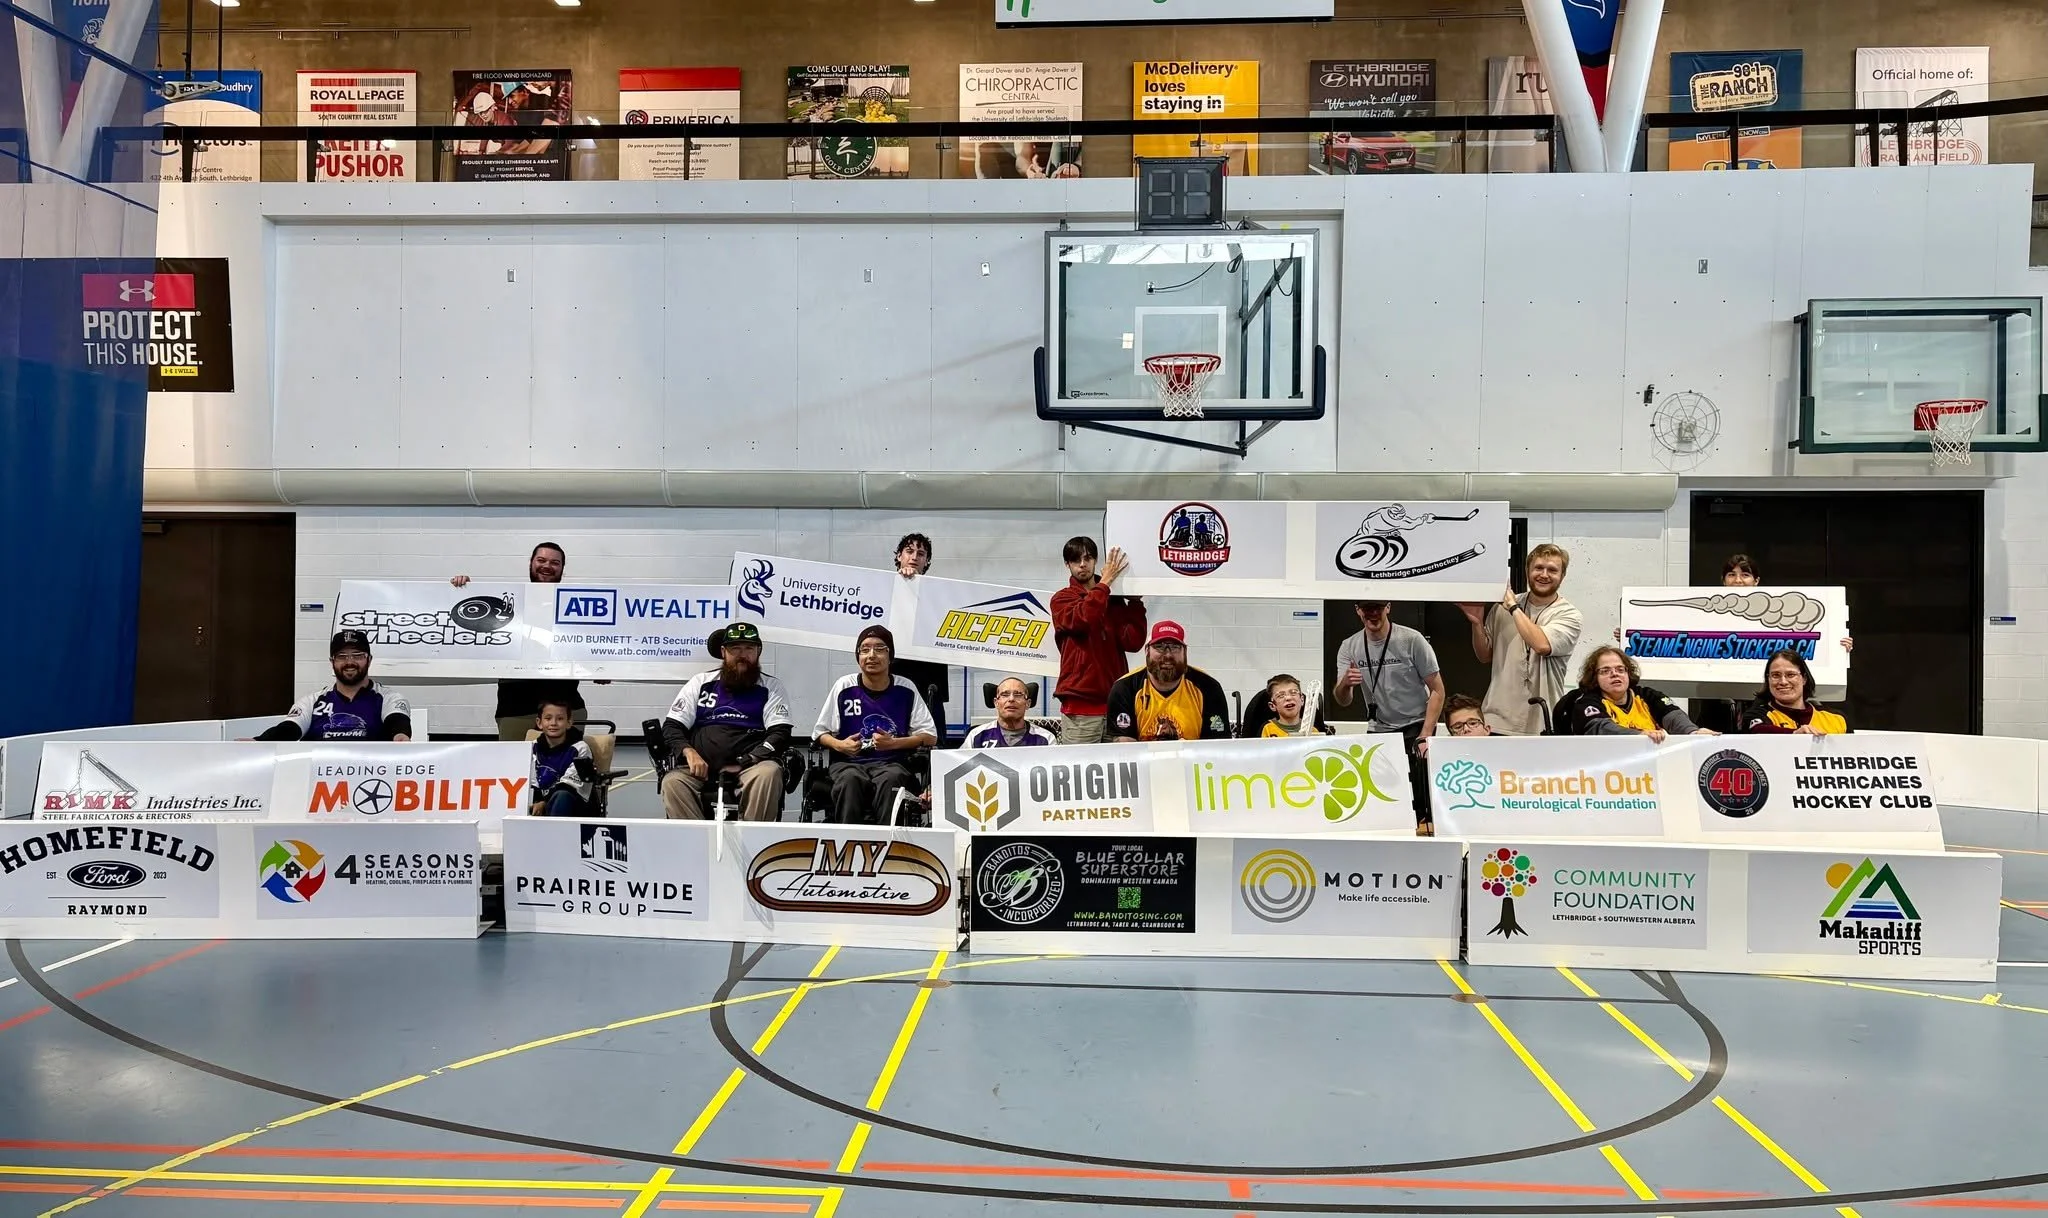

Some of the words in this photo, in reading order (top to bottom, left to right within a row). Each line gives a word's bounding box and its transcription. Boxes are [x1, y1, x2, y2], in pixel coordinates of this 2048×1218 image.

[806, 65, 830, 73] COME
[1321, 63, 1430, 72] LETHBRIDGE
[1872, 68, 1916, 80] Official
[1919, 69, 1954, 79] home
[1957, 68, 1973, 79] of:
[965, 76, 1078, 92] CHIROPRACTIC
[1144, 79, 1186, 93] loves
[1349, 74, 1430, 87] HYUNDAI
[1709, 76, 1769, 99] RANCH
[310, 90, 356, 101] ROYAL
[1001, 92, 1041, 101] CENTRAL
[1380, 91, 1398, 104] sell
[1399, 93, 1417, 107] you
[1700, 83, 1710, 100] THE
[1143, 96, 1203, 112] staying
[1206, 96, 1222, 109] in
[824, 154, 843, 172] GOLF
[843, 154, 872, 174] CENTRE
[1939, 153, 1970, 162] FIELD
[83, 310, 196, 340] PROTECT
[83, 342, 127, 365] THIS
[132, 343, 203, 366] HOUSE.
[1162, 550, 1226, 561] LETHBRIDGE
[1370, 569, 1411, 578] Lethbridge
[1411, 556, 1460, 575] Powerhockey
[782, 576, 845, 597] University
[847, 585, 861, 597] of
[563, 597, 608, 617] ATB
[625, 598, 729, 619] WEALTH
[779, 591, 884, 620] Lethbridge
[339, 609, 452, 627] street
[936, 609, 1051, 650] ACPSA
[553, 634, 583, 644] DAVID
[585, 635, 632, 645] BURNETT
[641, 636, 661, 645] ATB
[662, 636, 709, 646] Securities
[590, 646, 692, 657] www.atb.com/wealth
[934, 641, 956, 649] Alberta
[956, 643, 980, 652] Cerebral
[981, 646, 996, 654] Palsy
[996, 648, 1015, 656] Sports
[1015, 650, 1047, 659] Association
[697, 690, 719, 708] 25
[312, 700, 334, 716] 24
[844, 699, 862, 716] 26
[317, 765, 387, 776] LEADING
[395, 764, 436, 775] EDGE
[1793, 756, 1918, 770] LETHBRIDGE
[1029, 762, 1140, 803] ORIGIN
[1499, 769, 1596, 796] Branch
[1604, 770, 1656, 796] Out
[1709, 767, 1754, 796] 40
[1795, 775, 1923, 790] HURRICANES
[146, 796, 229, 810] Industries
[232, 795, 262, 809] Inc.
[1501, 797, 1582, 813] Neurological
[1585, 797, 1657, 810] Foundation
[1792, 795, 1873, 809] HOCKEY
[1879, 795, 1933, 809] CLUB
[42, 812, 69, 821] STEEL
[71, 812, 135, 821] FABRICATORS
[136, 812, 144, 820] &
[145, 812, 192, 820] ERECTORS
[1042, 806, 1133, 822] PARTNERS
[0, 825, 215, 875] HOMEFIELD
[814, 838, 888, 877] MY
[985, 845, 1031, 871] BANDITOS
[1075, 851, 1116, 864] BLUE
[1122, 852, 1185, 866] COLLAR
[46, 871, 57, 880] EST
[83, 865, 131, 885] Ford
[153, 871, 167, 880] 2023
[334, 854, 361, 885] 4
[364, 853, 474, 869] SEASONS
[365, 869, 404, 879] HOME
[409, 869, 474, 879] COMFORT
[1080, 863, 1179, 877] SUPERSTORE
[776, 872, 912, 901] Automotive
[1323, 871, 1444, 891] MOTION
[1554, 868, 1697, 889] COMMUNITY
[516, 875, 616, 897] PRAIRIE
[627, 880, 693, 901] WIDE
[1003, 880, 1061, 921] INCORPORATED
[1338, 893, 1363, 902] Make
[1365, 893, 1380, 903] life
[1381, 894, 1430, 904] accessible.
[1553, 891, 1695, 912] FOUNDATION
[67, 905, 148, 915] RAYMOND
[562, 900, 647, 917] GROUP
[1073, 911, 1183, 921] WWW.BANDITOSINC.COM
[1552, 914, 1597, 922] LETHBRIDGE
[1603, 915, 1663, 924] SOUTHWESTERN
[1663, 917, 1696, 925] ALBERTA
[1819, 919, 1922, 941] Makadiff
[1858, 940, 1922, 956] SPORTS
